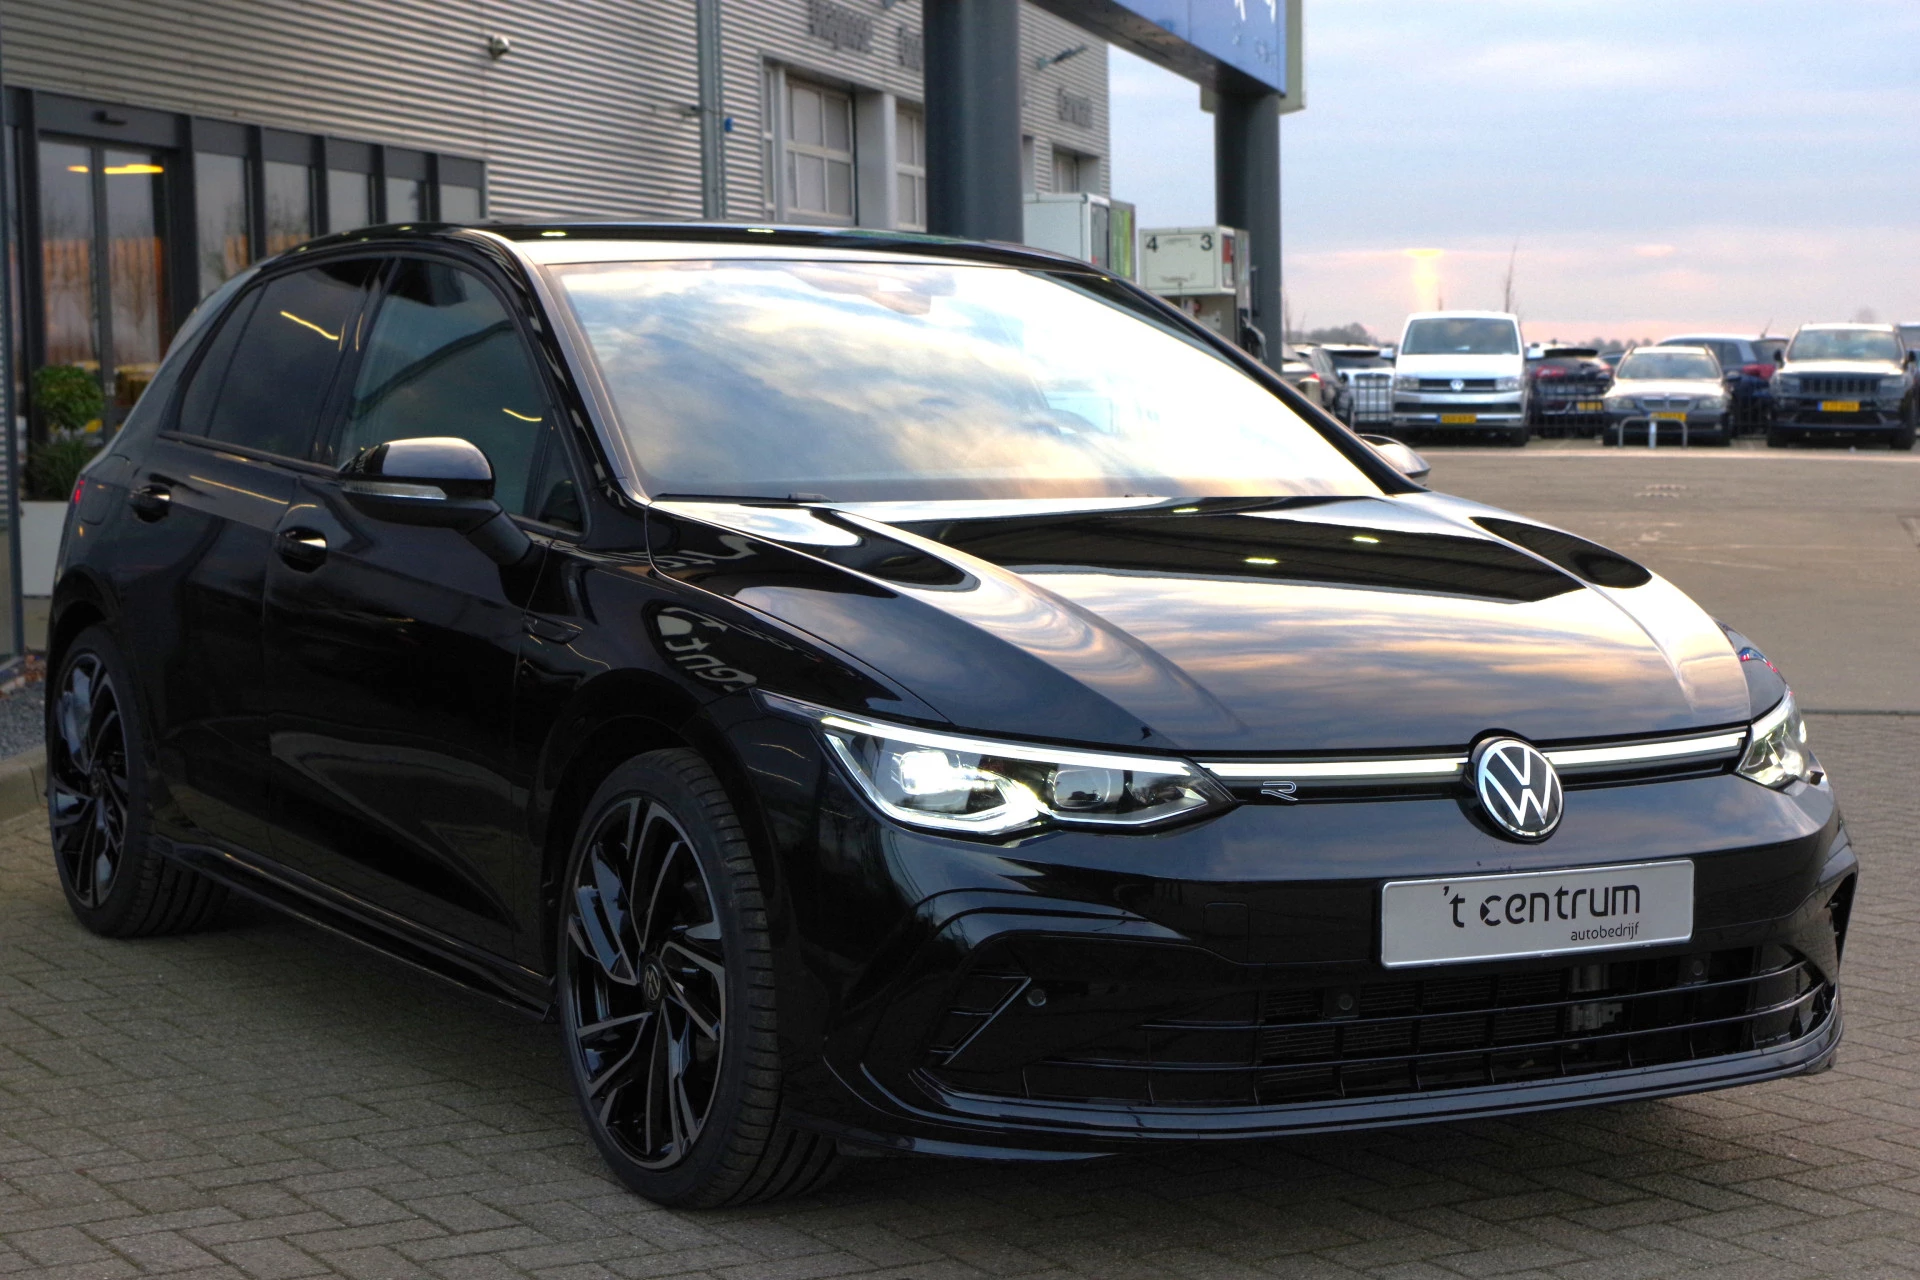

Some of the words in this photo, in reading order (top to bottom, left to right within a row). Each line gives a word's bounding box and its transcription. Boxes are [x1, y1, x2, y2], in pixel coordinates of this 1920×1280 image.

[1146, 234, 1158, 252] 4
[1200, 233, 1213, 251] 3
[1479, 884, 1641, 927] centrum
[1570, 921, 1640, 942] autobedrijf
